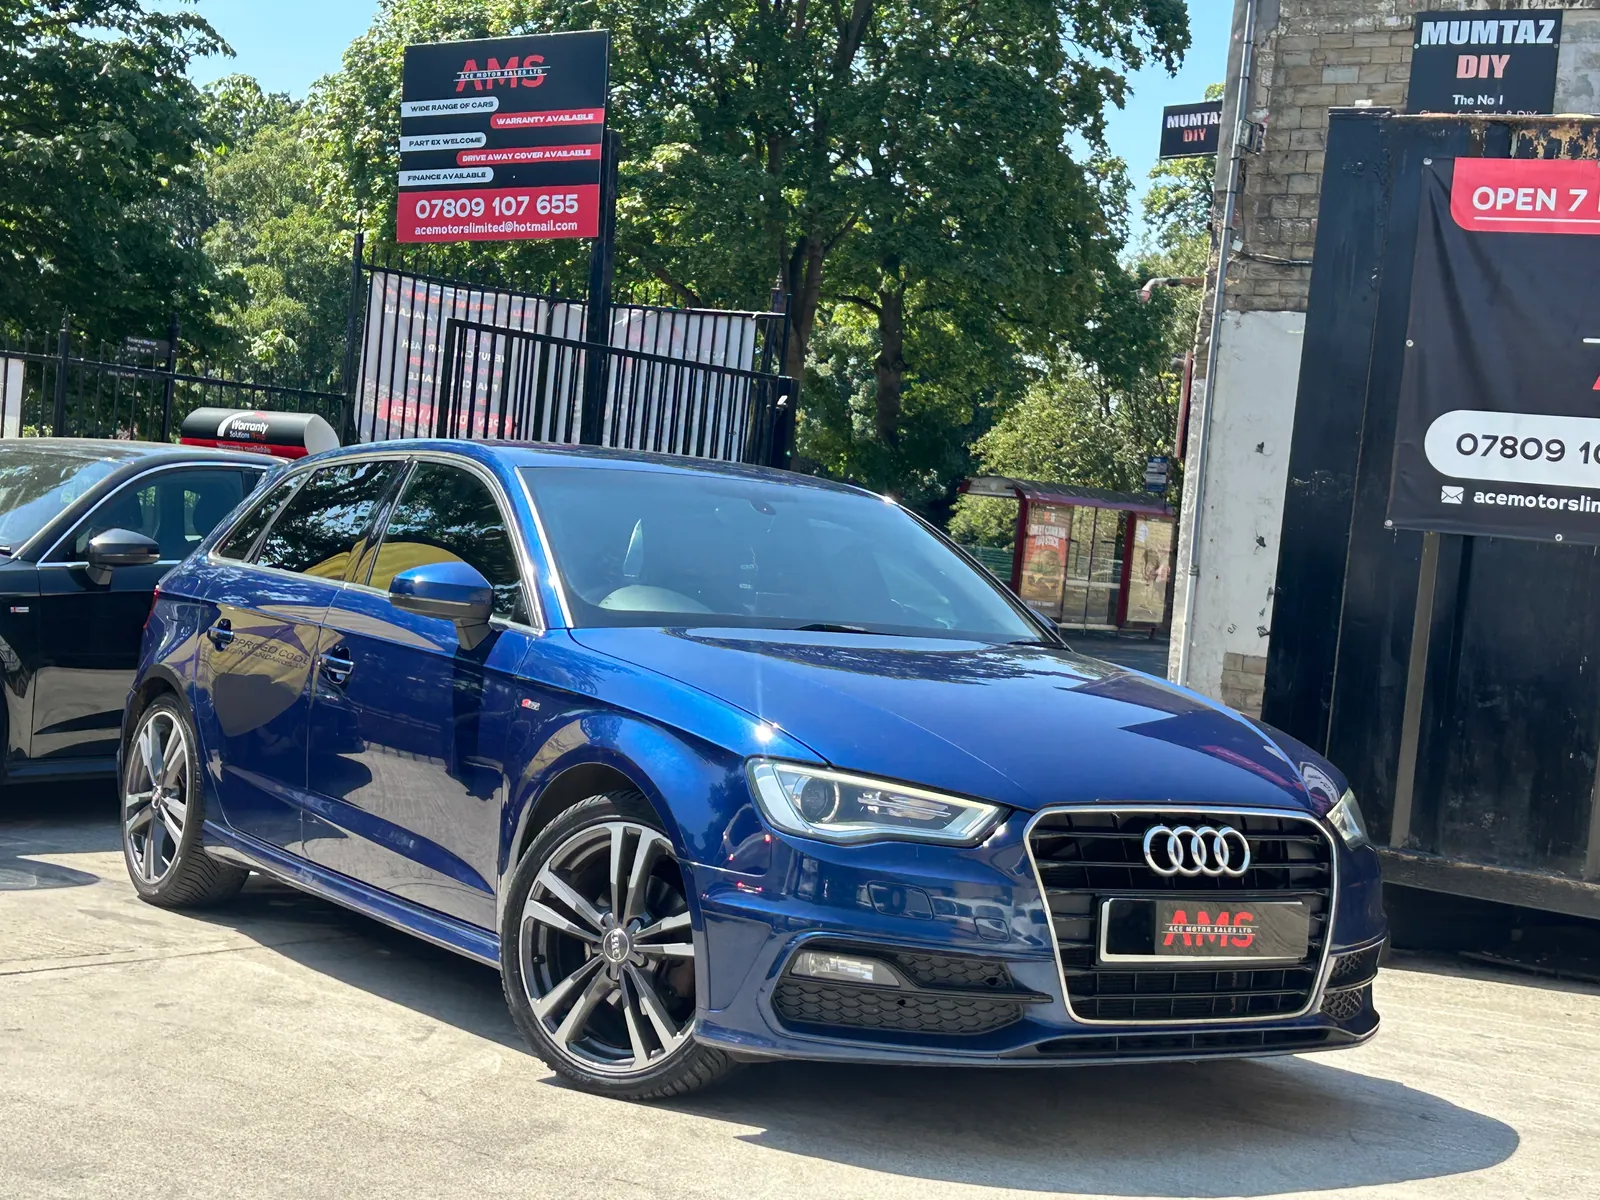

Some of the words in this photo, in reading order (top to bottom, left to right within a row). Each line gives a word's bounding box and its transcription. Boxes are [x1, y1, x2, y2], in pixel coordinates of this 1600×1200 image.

[1420, 19, 1556, 46] MUMTAZ
[456, 55, 544, 92] AMS
[1456, 54, 1511, 79] DIY
[410, 105, 430, 113] WIDE
[431, 103, 458, 111] RANGE
[459, 102, 471, 110] OF
[471, 101, 494, 109] CARS
[1452, 94, 1475, 106] The
[1477, 94, 1495, 106] No
[496, 115, 545, 125] WARRANTY
[545, 113, 594, 123] AVAILABLE
[1167, 111, 1222, 129] MUMTA
[442, 137, 482, 145] WELCOME
[1183, 128, 1207, 143] DIY
[462, 154, 487, 163] DRIVE
[487, 153, 514, 161] AWAY
[514, 151, 544, 160] COVER
[544, 149, 592, 158] AVAILABLE
[407, 174, 441, 182] FINANCE
[442, 172, 487, 180] AVAILABLE
[415, 197, 485, 219] 07809
[492, 195, 530, 217] 107
[536, 193, 579, 215] 655
[1472, 186, 1557, 212] OPEN
[1568, 188, 1588, 212] 7
[414, 219, 578, 236] acemotorslimited@hotmail.com
[230, 430, 250, 439] Solutions
[231, 419, 269, 435] Warranty
[1456, 432, 1566, 463] 07809
[1163, 909, 1254, 948] AMS
[1214, 926, 1237, 934] SALES
